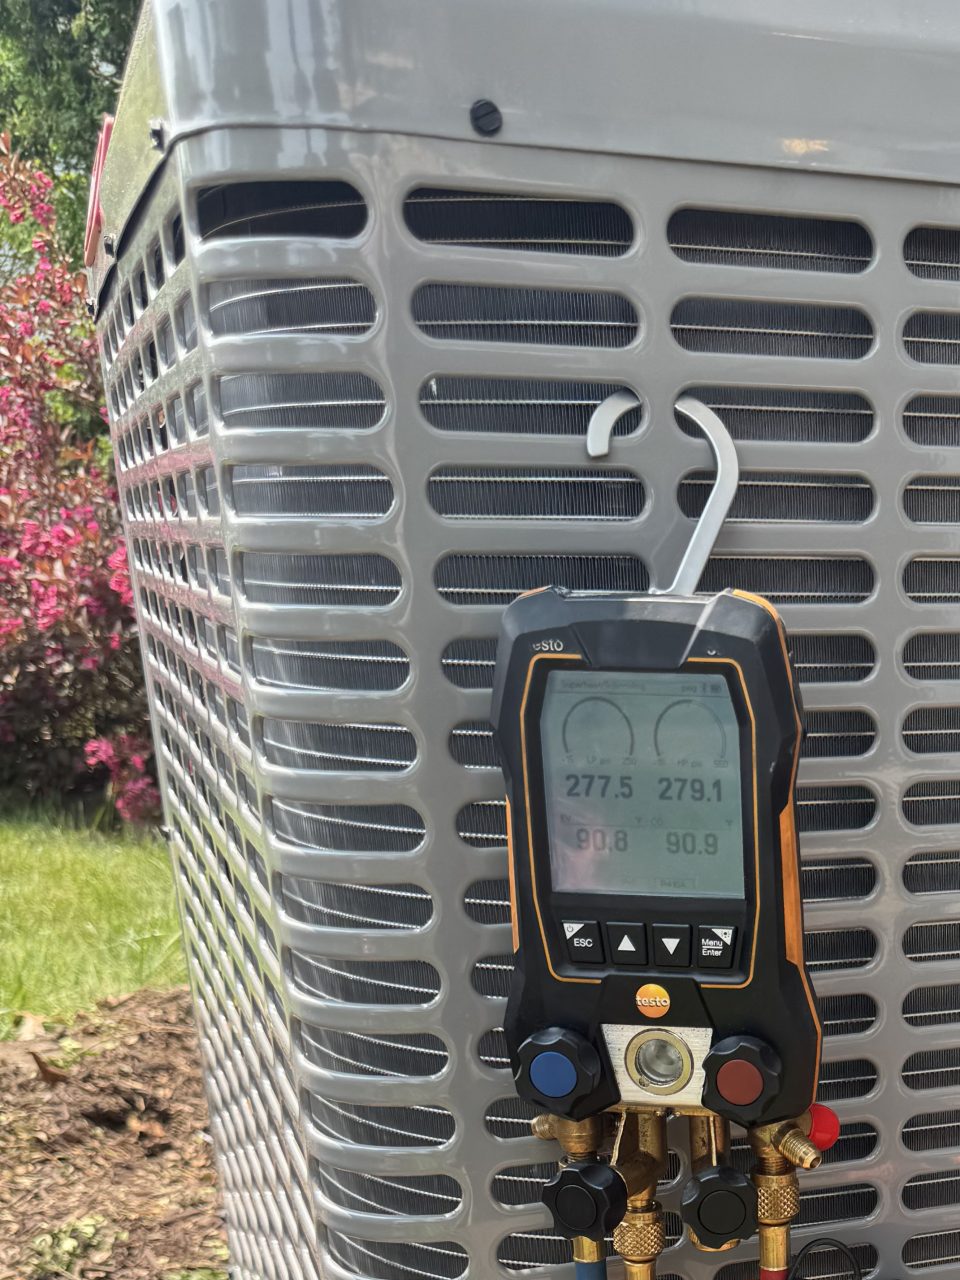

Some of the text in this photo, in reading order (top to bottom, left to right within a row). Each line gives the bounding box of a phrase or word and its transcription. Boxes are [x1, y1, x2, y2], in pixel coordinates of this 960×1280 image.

[566, 774, 722, 802] 277.5 279.1
[576, 828, 718, 855] 90.8 90.9
[573, 938, 593, 947] ESC
[701, 938, 723, 947] Menu
[702, 948, 722, 957] Enter
[635, 995, 670, 1007] testo
